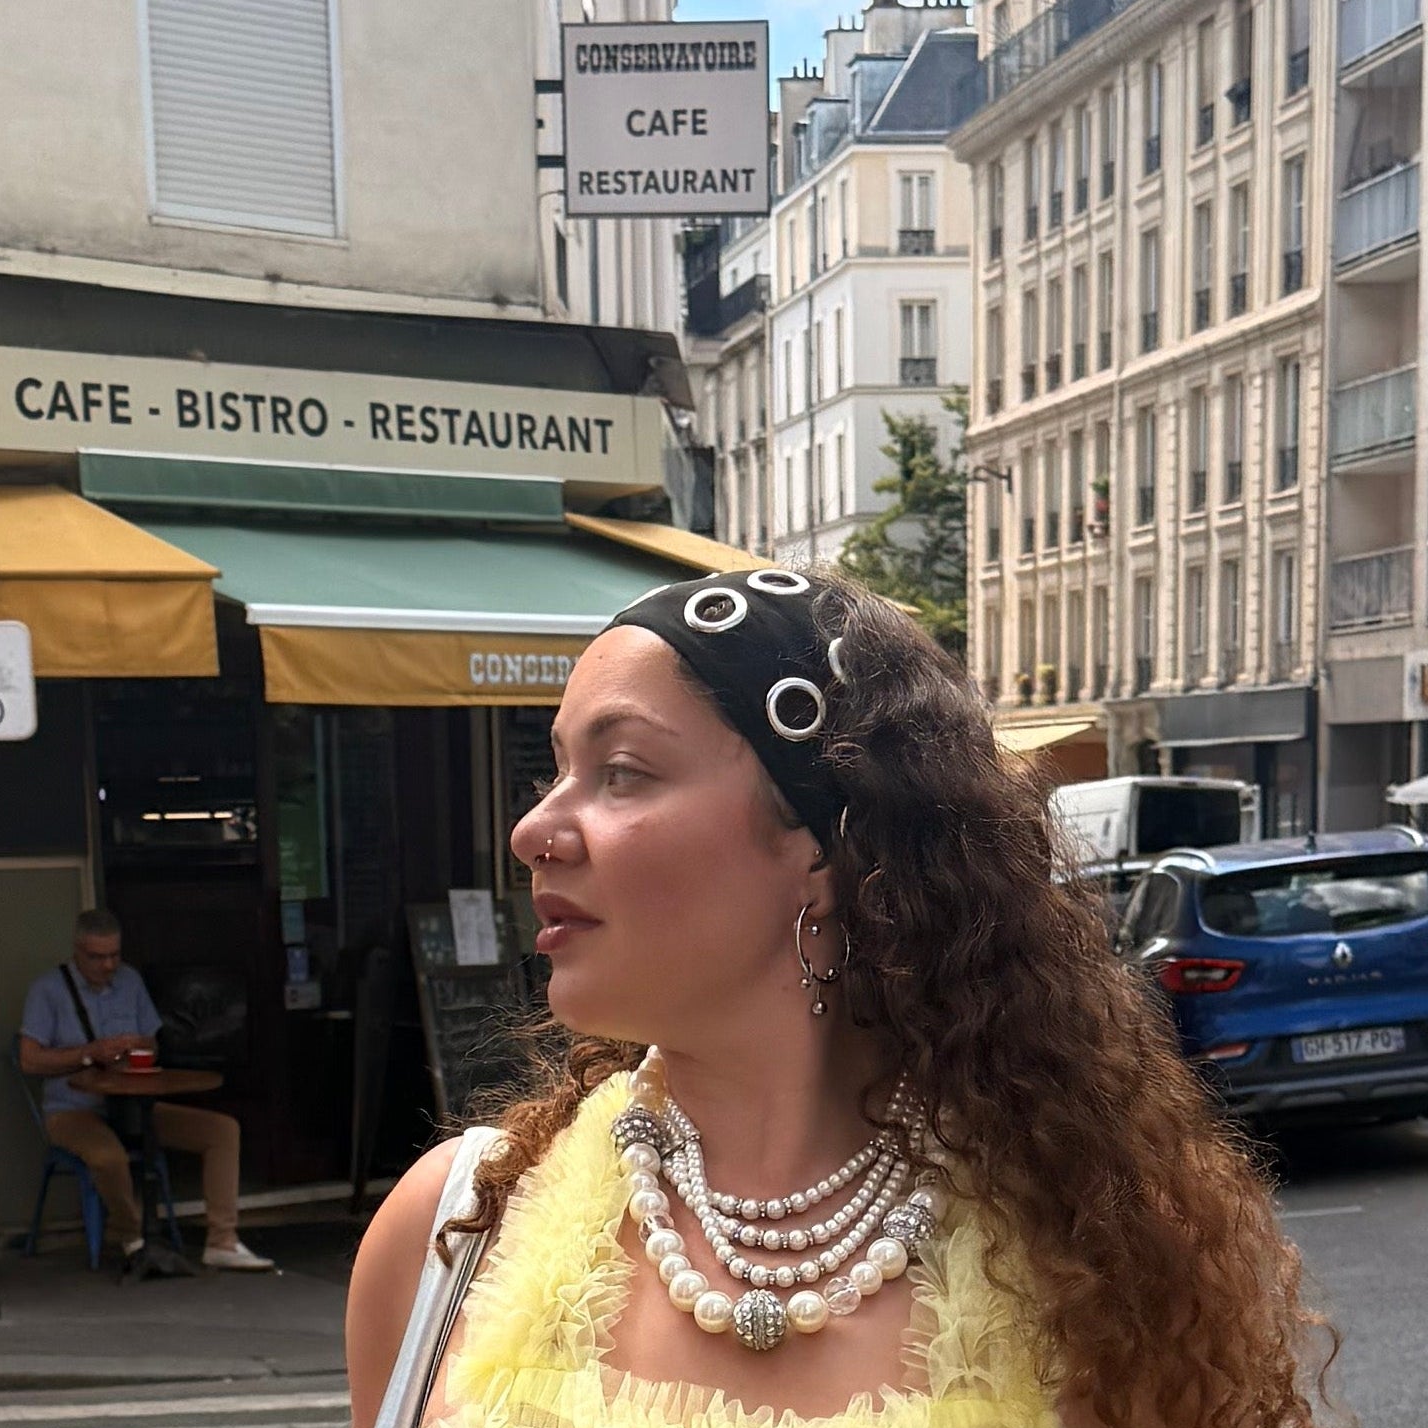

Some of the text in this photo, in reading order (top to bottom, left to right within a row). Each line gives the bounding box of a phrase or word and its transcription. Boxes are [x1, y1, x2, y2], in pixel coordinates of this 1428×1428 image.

[576, 41, 756, 73] CONSERVATOIRE
[626, 108, 708, 137] CAFE
[579, 168, 756, 195] RESTAURANT
[14, 376, 132, 425] CAFE
[176, 387, 328, 438] BISTRO
[371, 401, 614, 456] RESTAURANT
[470, 652, 579, 685] CONSER
